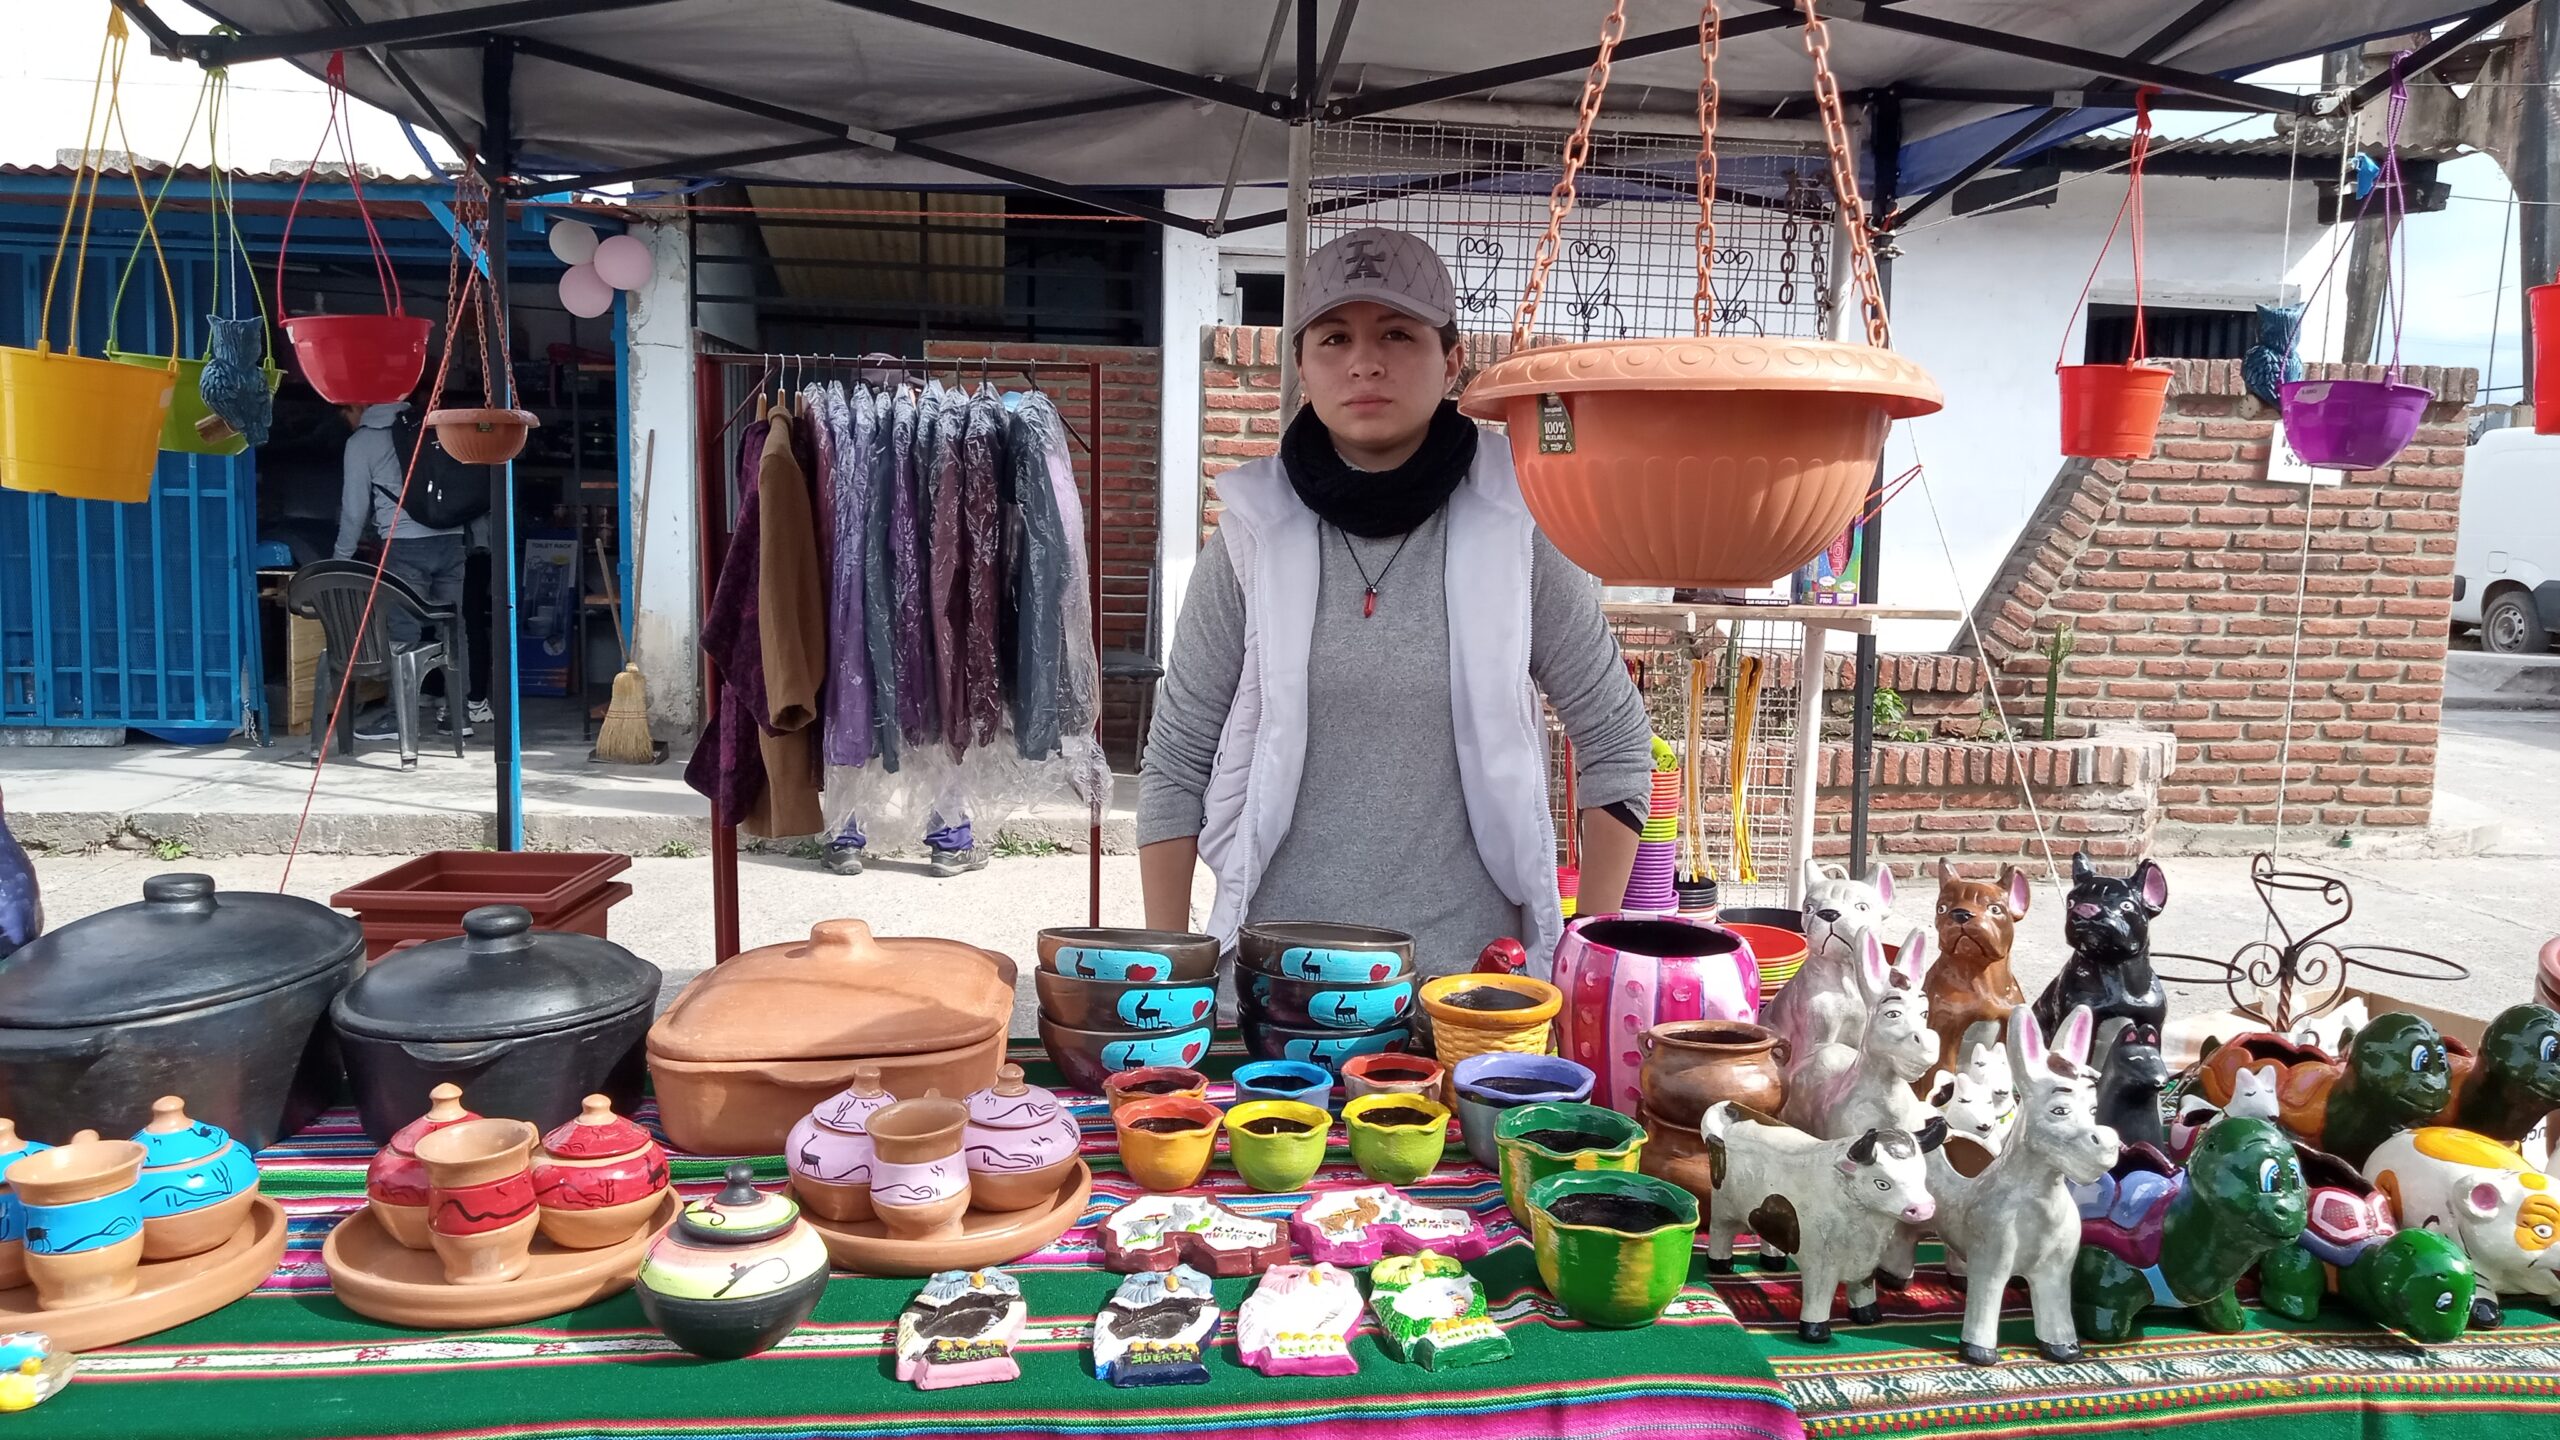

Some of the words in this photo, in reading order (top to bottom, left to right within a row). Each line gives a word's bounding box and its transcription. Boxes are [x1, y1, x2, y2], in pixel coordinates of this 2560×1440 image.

[1544, 421, 1567, 434] 100%
[937, 1348, 999, 1361] SUERTE
[1131, 1352, 1192, 1365] SUERTE
